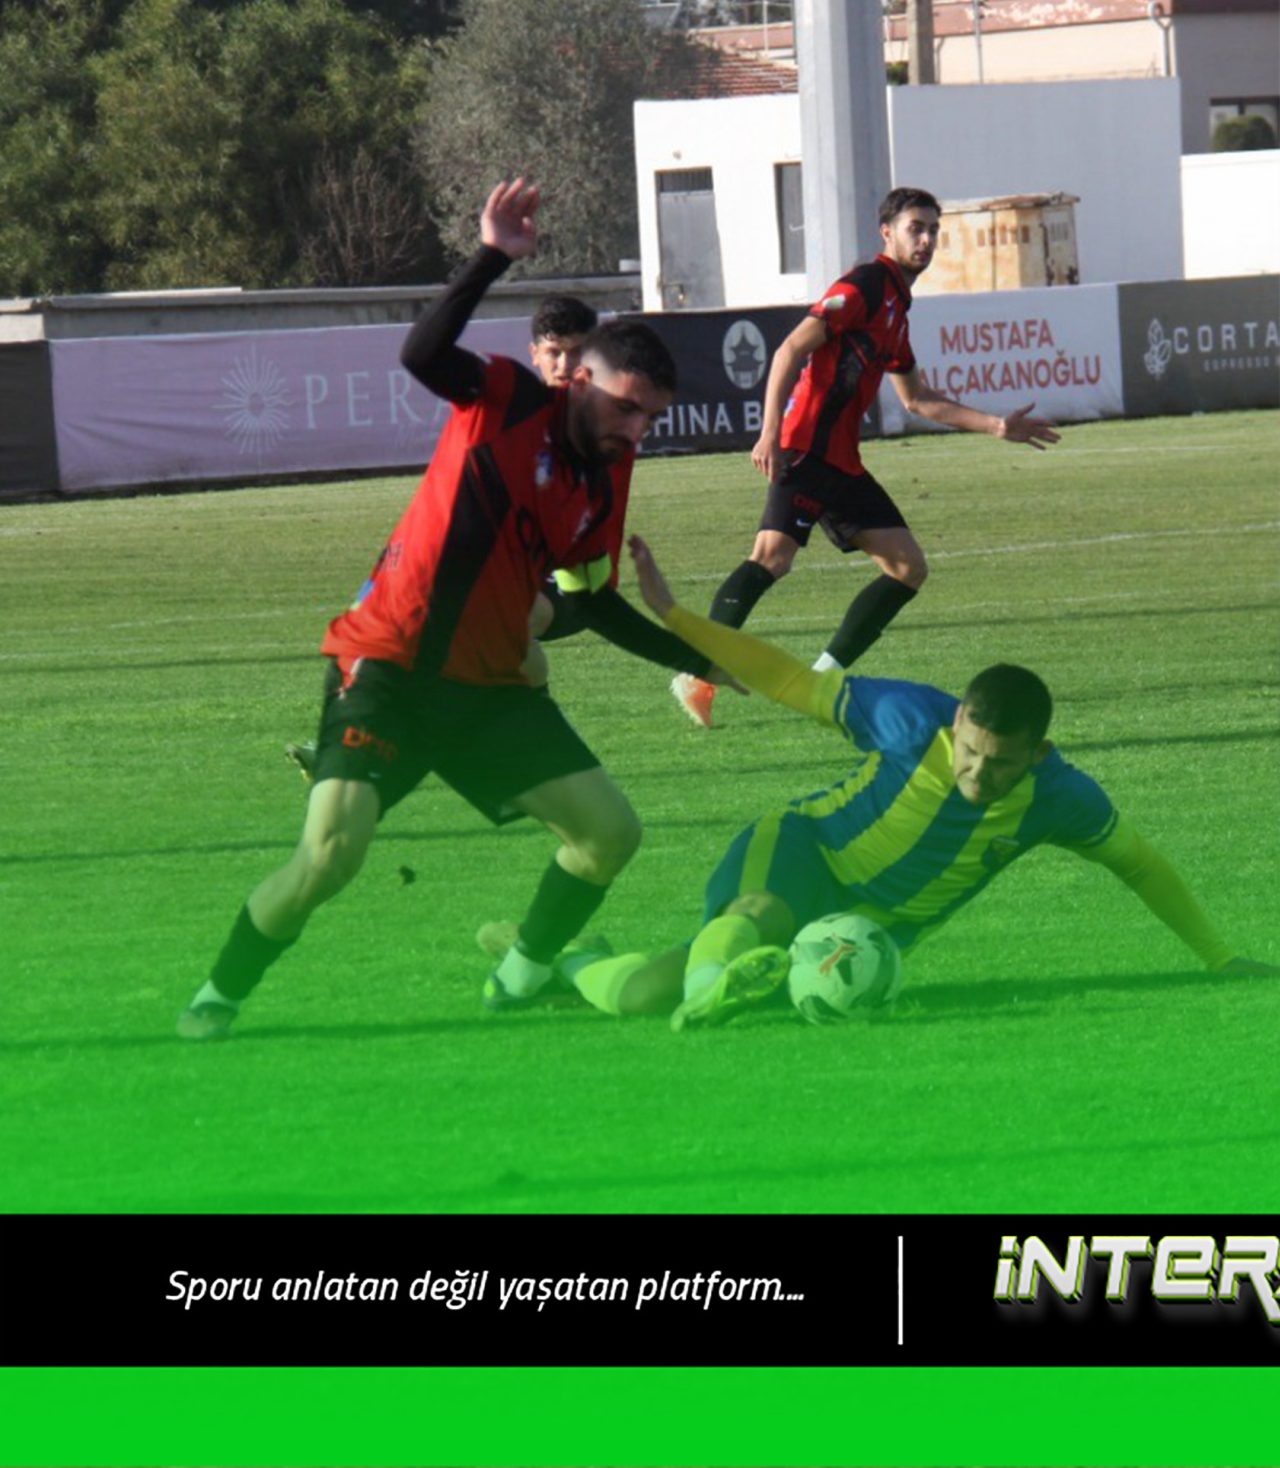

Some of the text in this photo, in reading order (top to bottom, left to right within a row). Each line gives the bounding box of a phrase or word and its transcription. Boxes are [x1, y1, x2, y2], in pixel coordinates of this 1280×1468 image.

[939, 319, 1055, 355] MUSTAFA
[1173, 320, 1280, 354] CORTA
[916, 350, 1102, 401] ALÇAKANOĞLU
[643, 402, 733, 438] HINA
